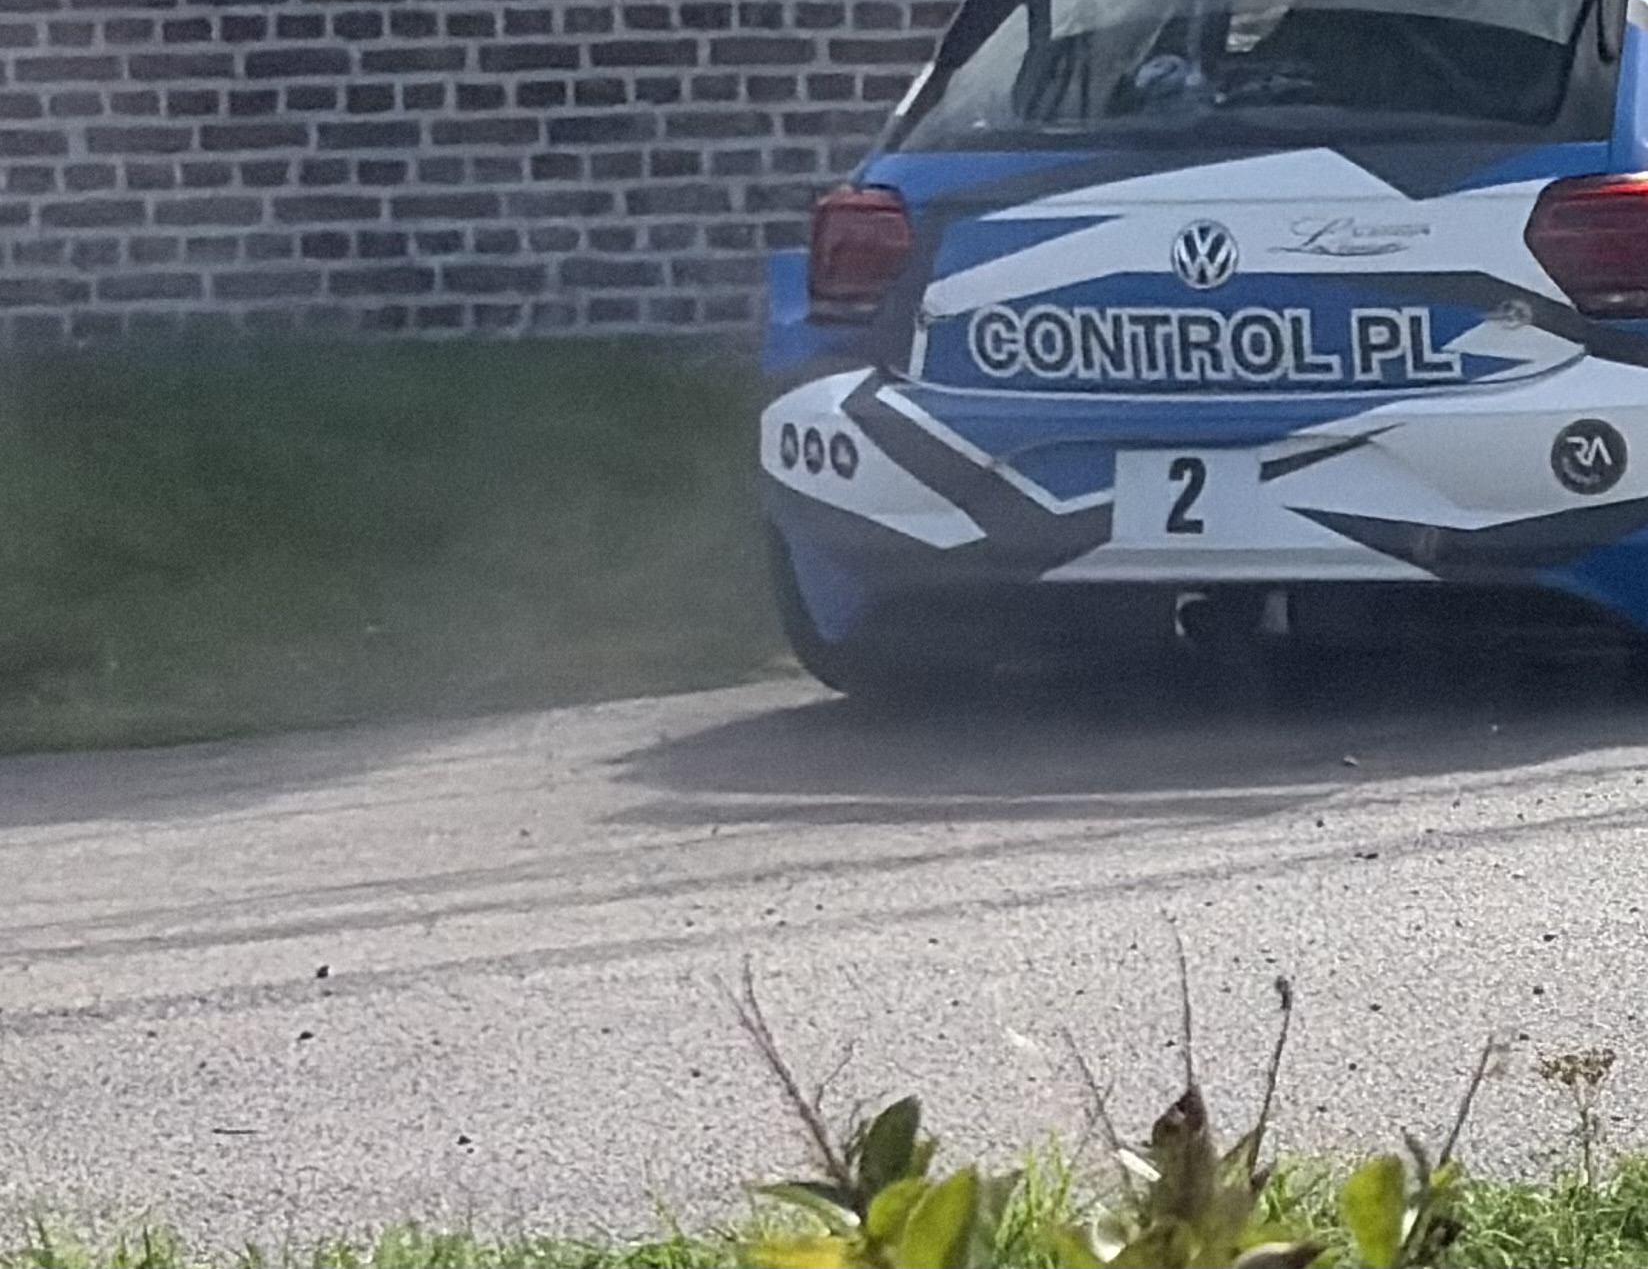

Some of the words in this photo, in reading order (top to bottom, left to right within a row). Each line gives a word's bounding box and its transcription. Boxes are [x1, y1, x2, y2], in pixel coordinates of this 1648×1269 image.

[968, 304, 1341, 381] CONTROL
[1352, 306, 1462, 381] PL
[1165, 457, 1208, 534] 2
